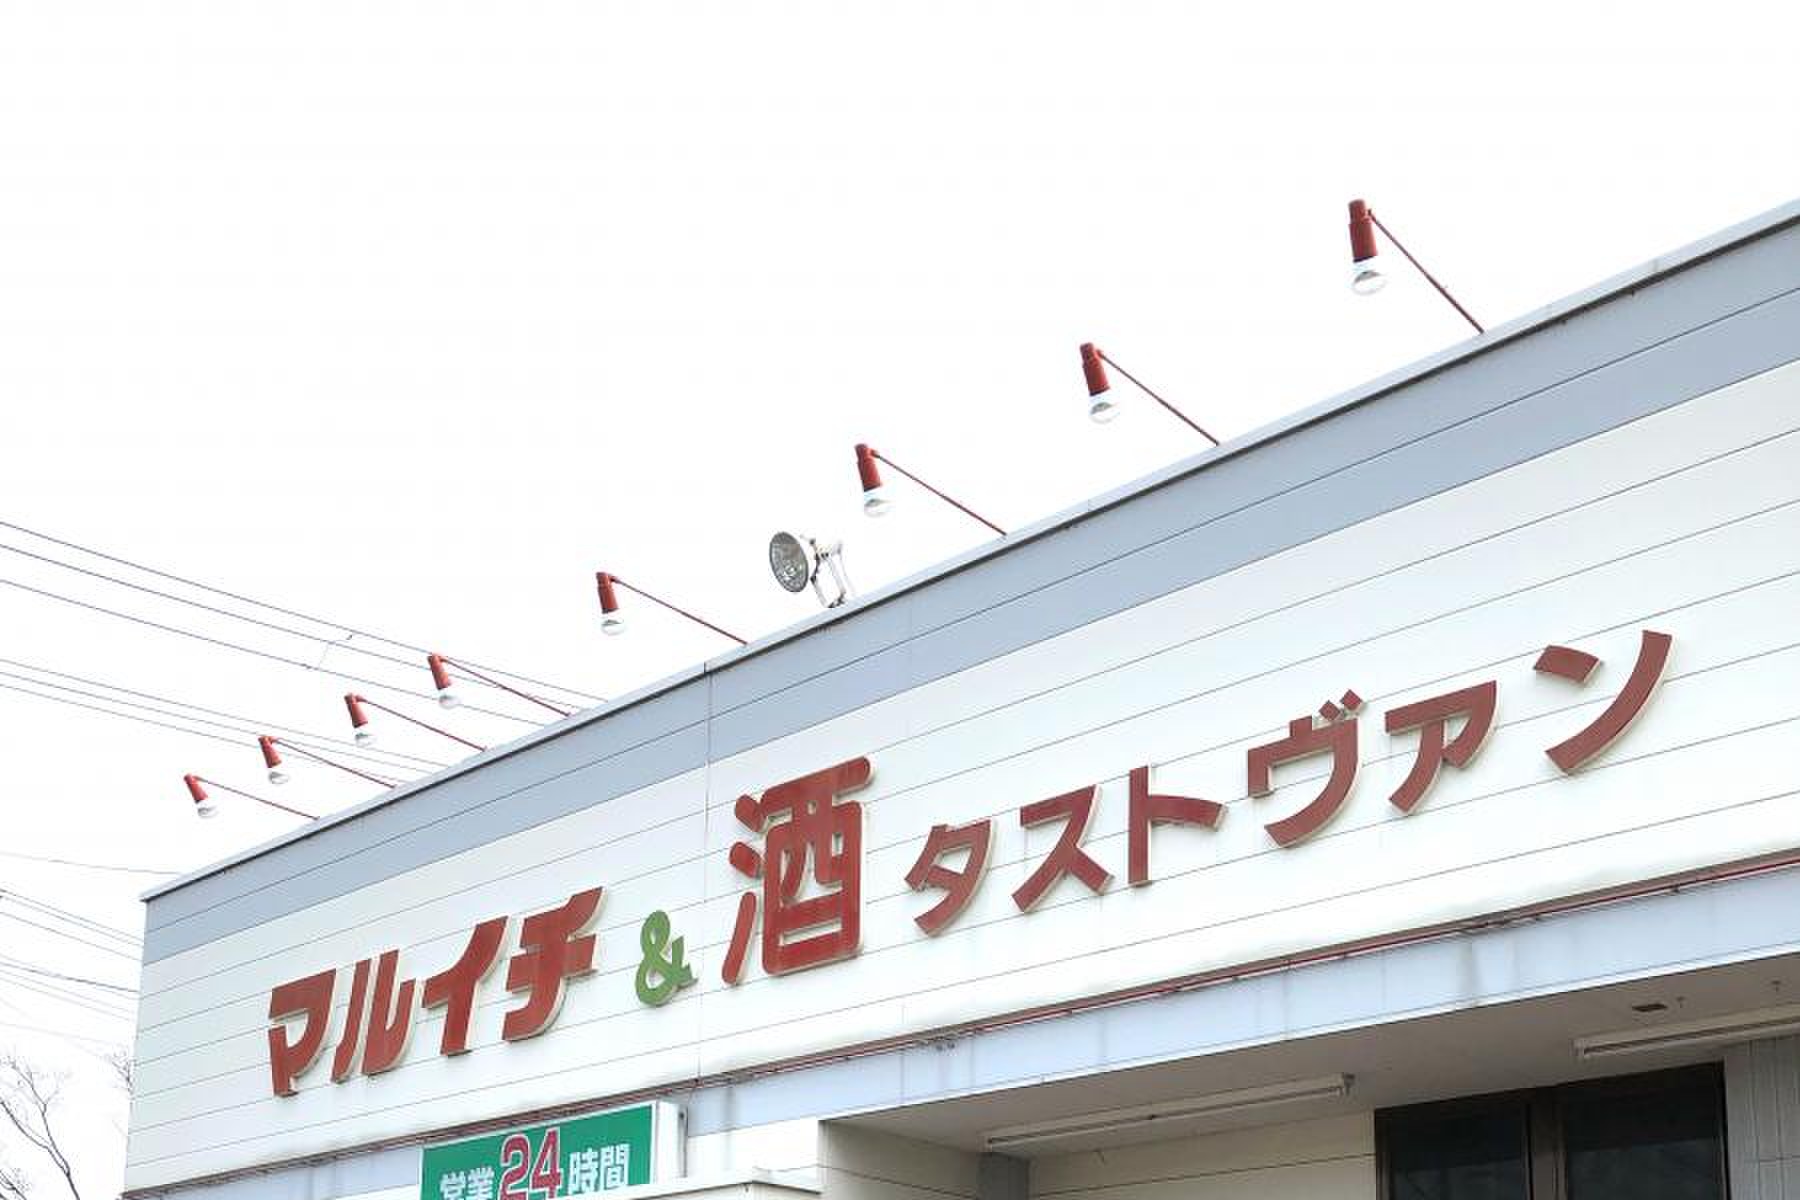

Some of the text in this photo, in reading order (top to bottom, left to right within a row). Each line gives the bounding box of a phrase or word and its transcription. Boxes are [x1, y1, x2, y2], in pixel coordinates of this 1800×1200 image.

[268, 629, 1676, 1097] マルイチ & 酒 タストヴァン
